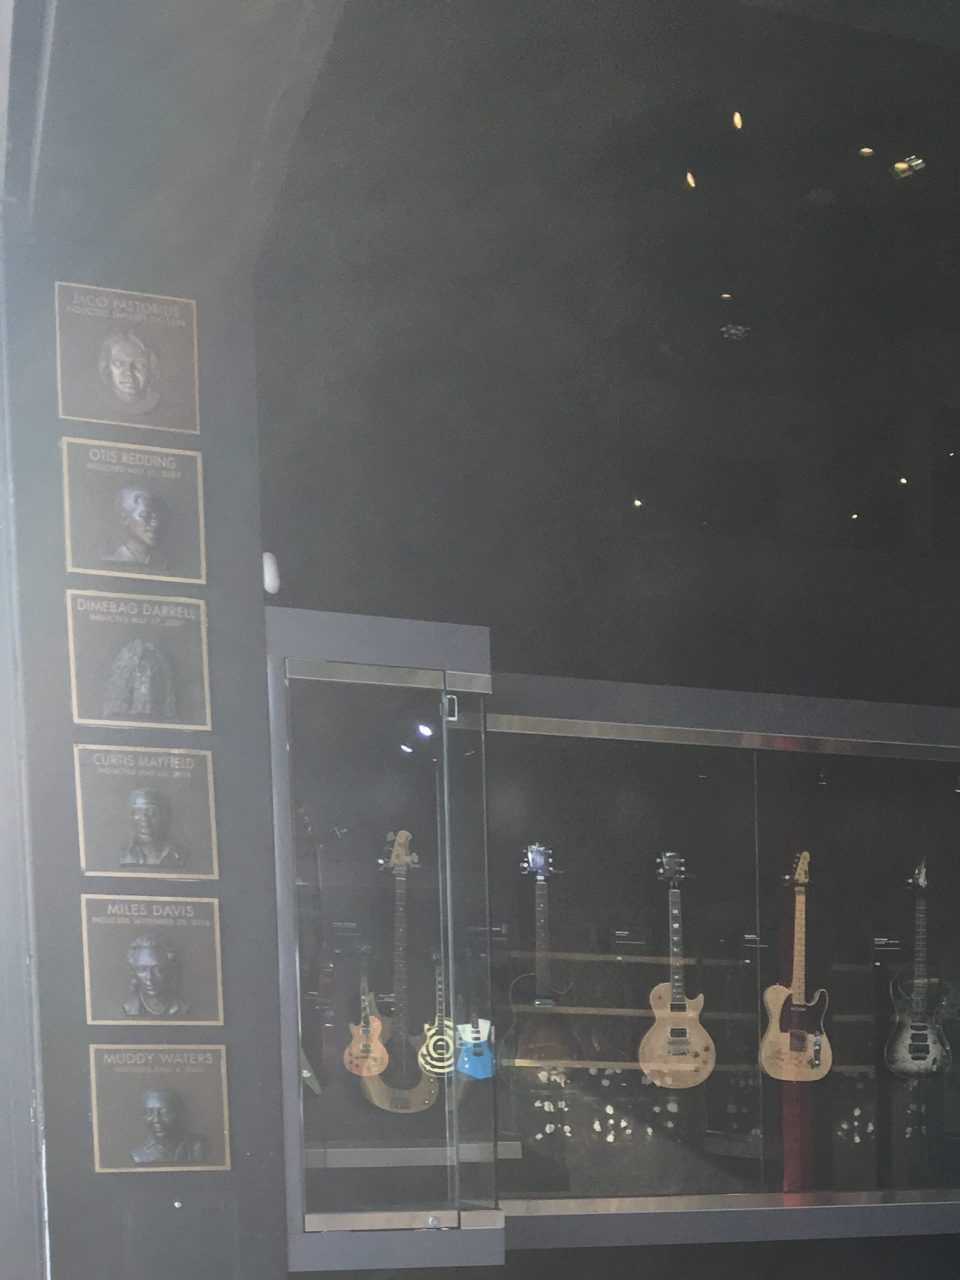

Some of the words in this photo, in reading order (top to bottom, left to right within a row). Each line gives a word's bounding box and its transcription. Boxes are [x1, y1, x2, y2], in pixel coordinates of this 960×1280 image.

[76, 598, 138, 614] DIMEBAG
[106, 903, 147, 916] MILES
[152, 904, 195, 918] DAVIS
[103, 1052, 153, 1065] MUDDY
[158, 1053, 214, 1065] WATERS
